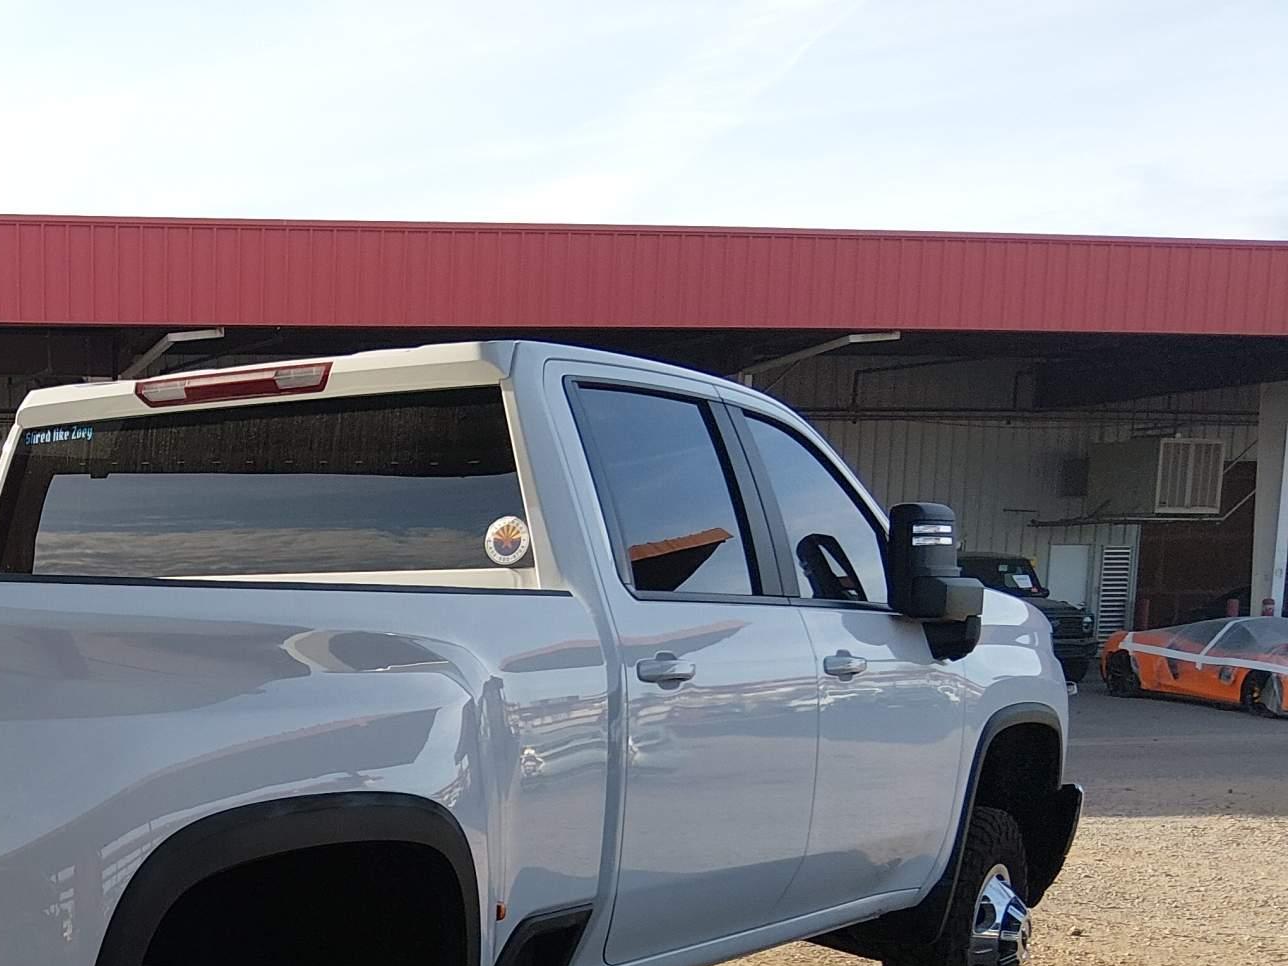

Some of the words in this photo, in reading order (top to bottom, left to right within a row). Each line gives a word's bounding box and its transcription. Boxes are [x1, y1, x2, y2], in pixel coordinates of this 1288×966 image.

[26, 430, 51, 444] Shred
[53, 428, 70, 441] like
[72, 426, 93, 440] Zoey
